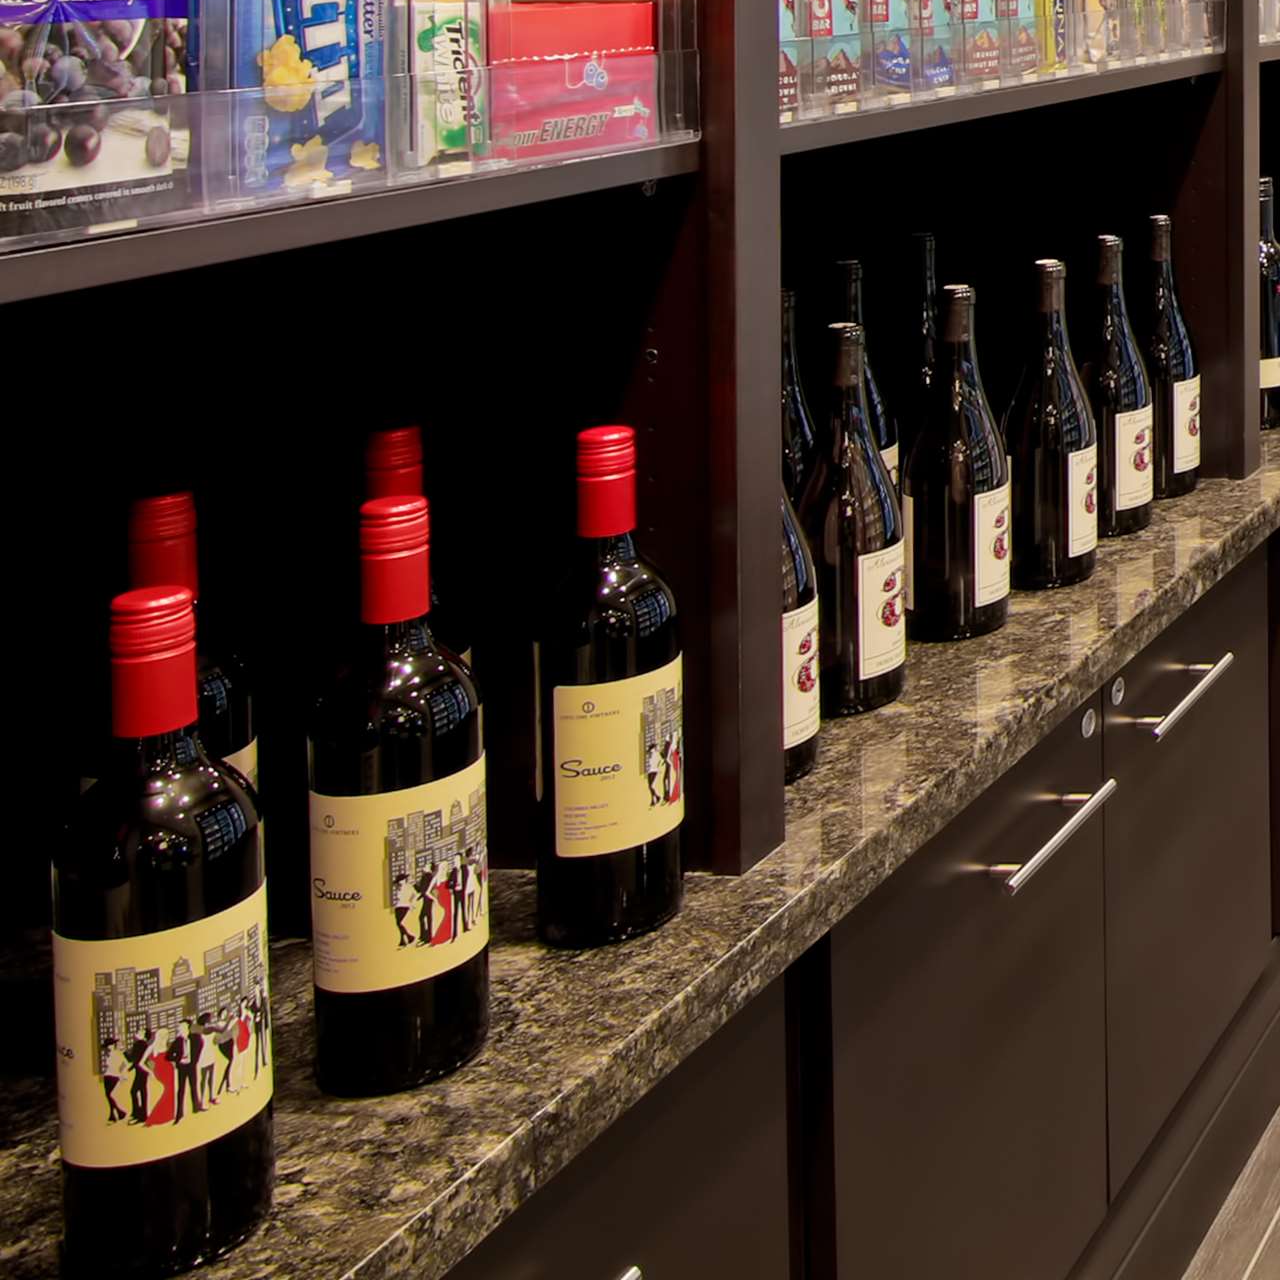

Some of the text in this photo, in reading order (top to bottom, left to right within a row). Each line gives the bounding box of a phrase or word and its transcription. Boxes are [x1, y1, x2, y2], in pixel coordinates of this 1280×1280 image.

[445, 21, 480, 123] Trident
[538, 113, 609, 142] ENERGY
[9, 201, 33, 211] fruit
[34, 197, 67, 210] flavored
[560, 759, 622, 779] Sauce
[313, 878, 362, 901] Sauce
